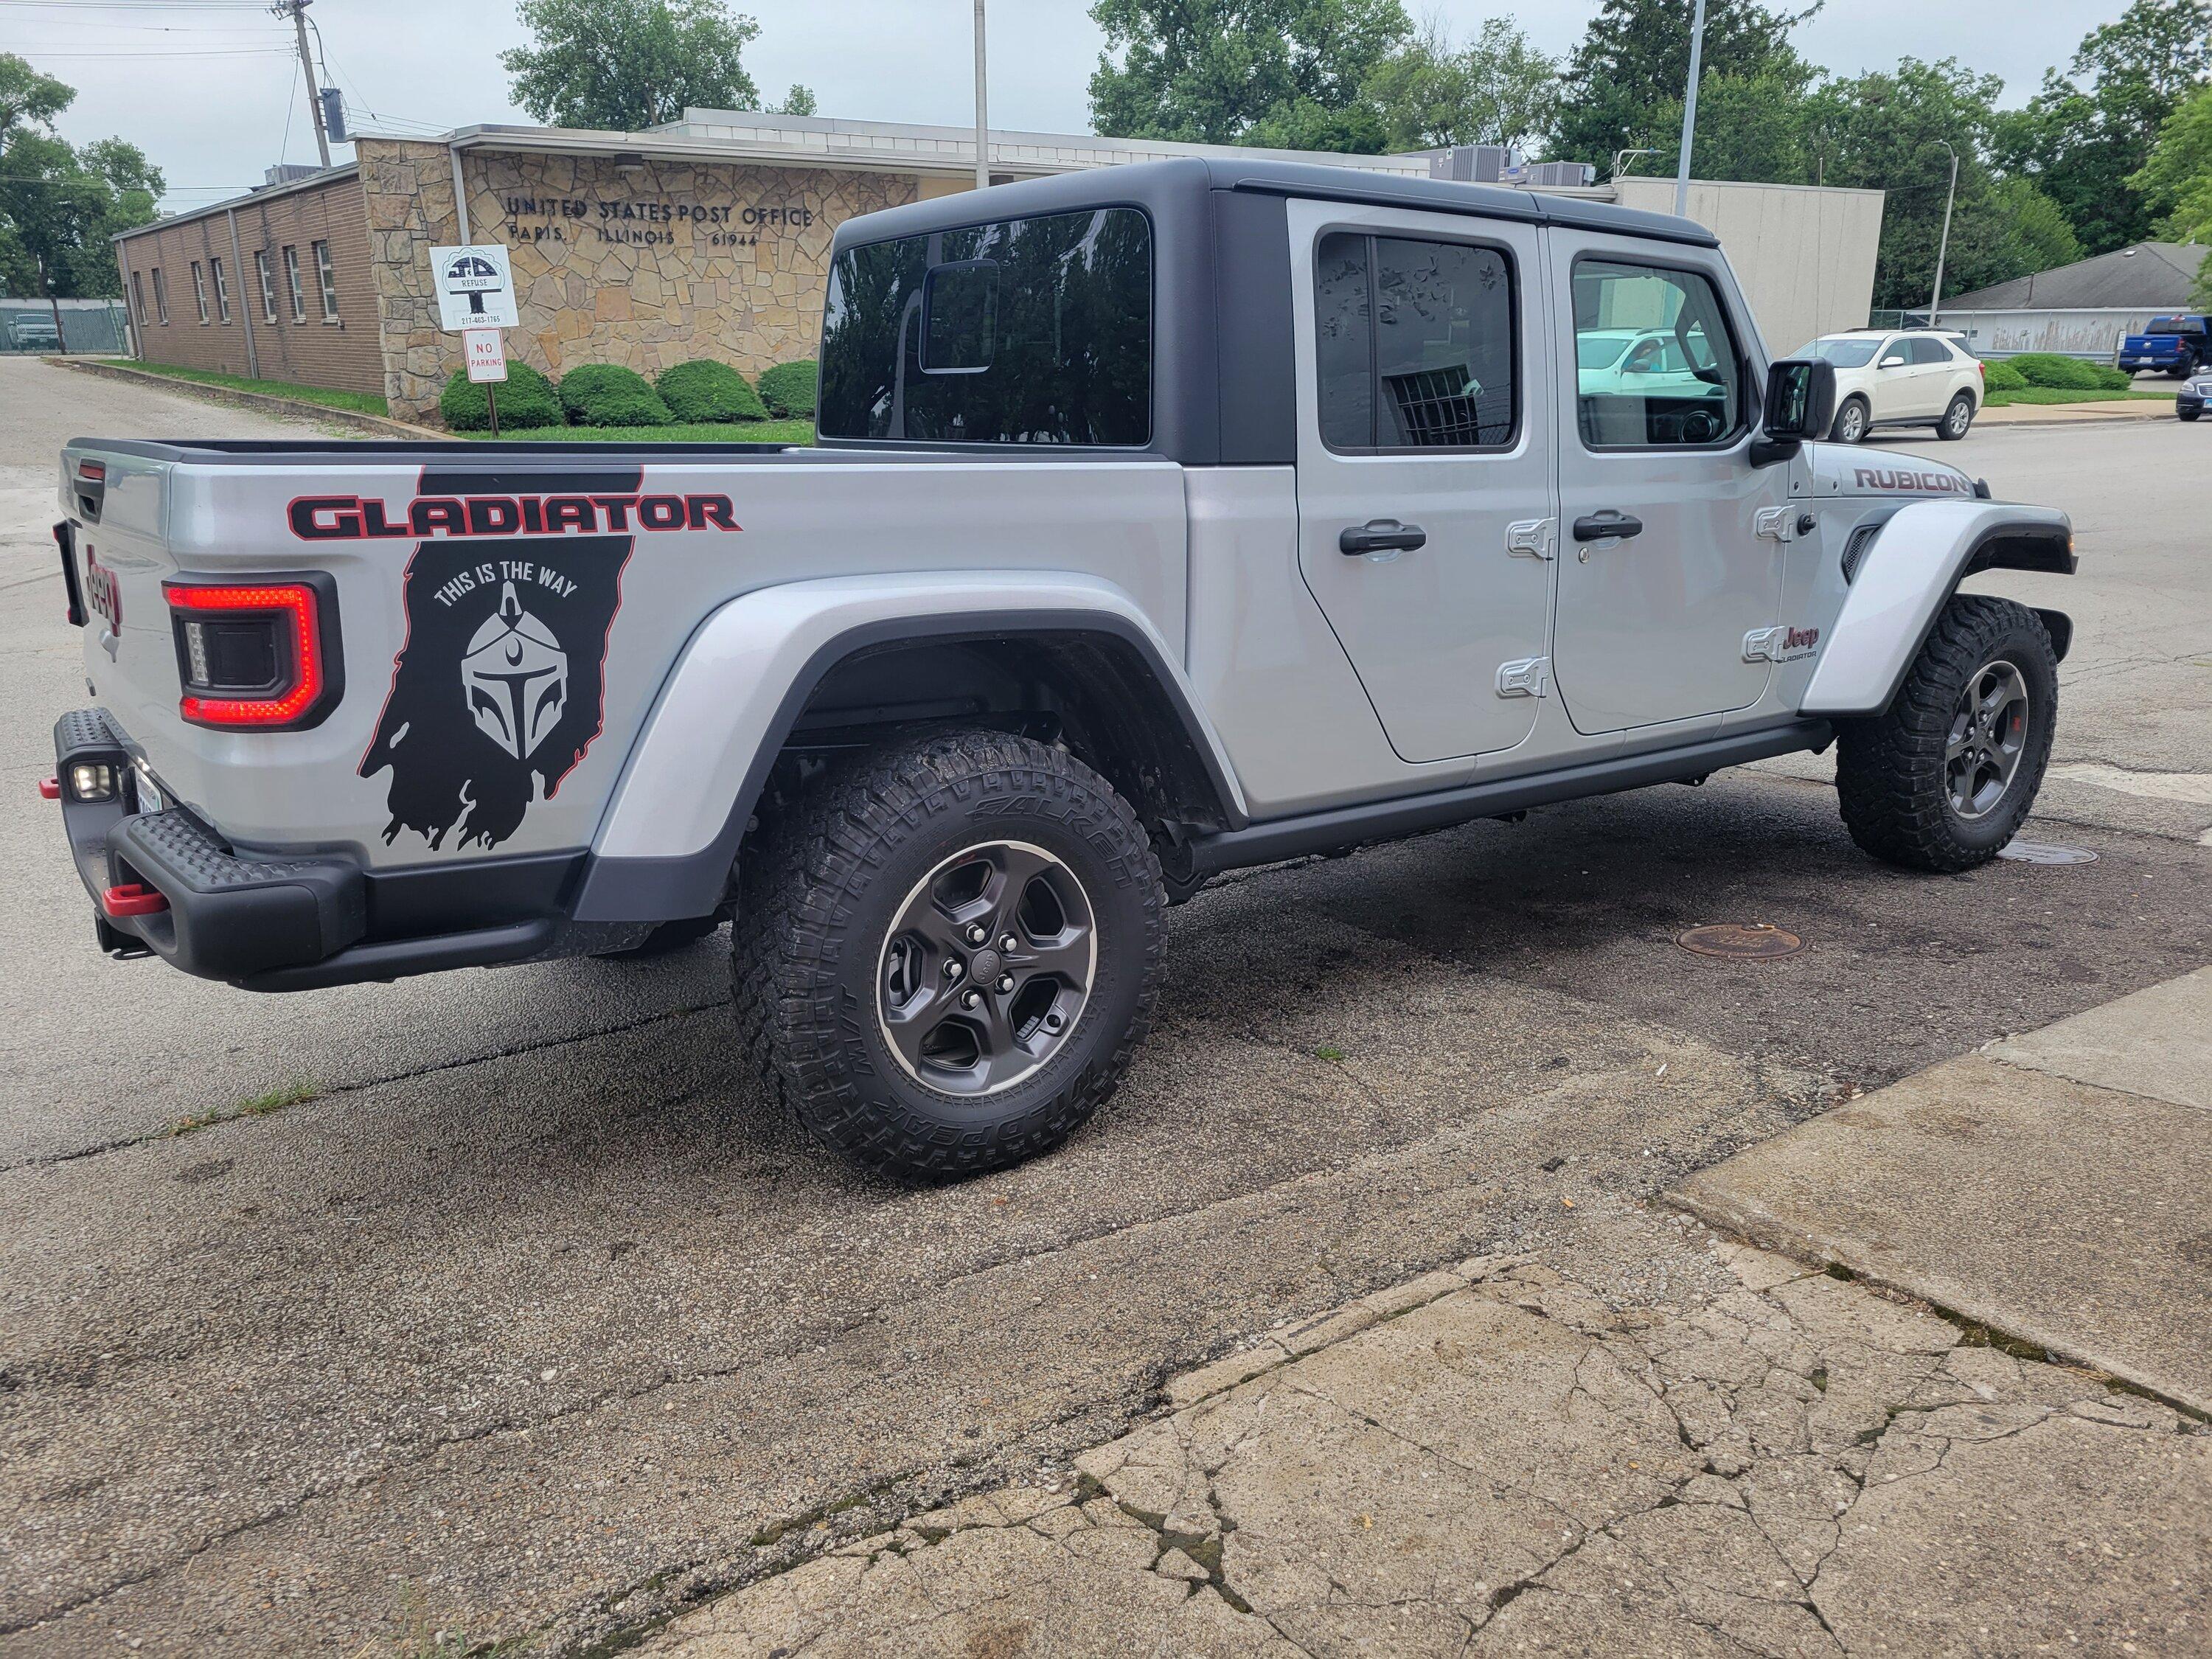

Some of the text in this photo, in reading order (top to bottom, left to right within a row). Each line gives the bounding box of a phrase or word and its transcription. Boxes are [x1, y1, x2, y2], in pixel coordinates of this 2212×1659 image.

[507, 196, 813, 227] UNITED STATES POST OFFICE
[598, 228, 675, 245] ILLINOIS
[712, 233, 757, 246] 61944
[462, 279, 488, 288] REFUSE
[461, 315, 501, 324] 217-463-1765
[476, 343, 493, 353] NO
[471, 358, 502, 367] PARKING
[1853, 468, 1970, 493] RUBICON
[287, 494, 744, 542] GLADIATOR
[433, 560, 578, 607] THIS IS THE WAY
[1783, 626, 1820, 650] Jeep
[964, 795, 1133, 889] FALKEN
[979, 953, 993, 979] Jeep
